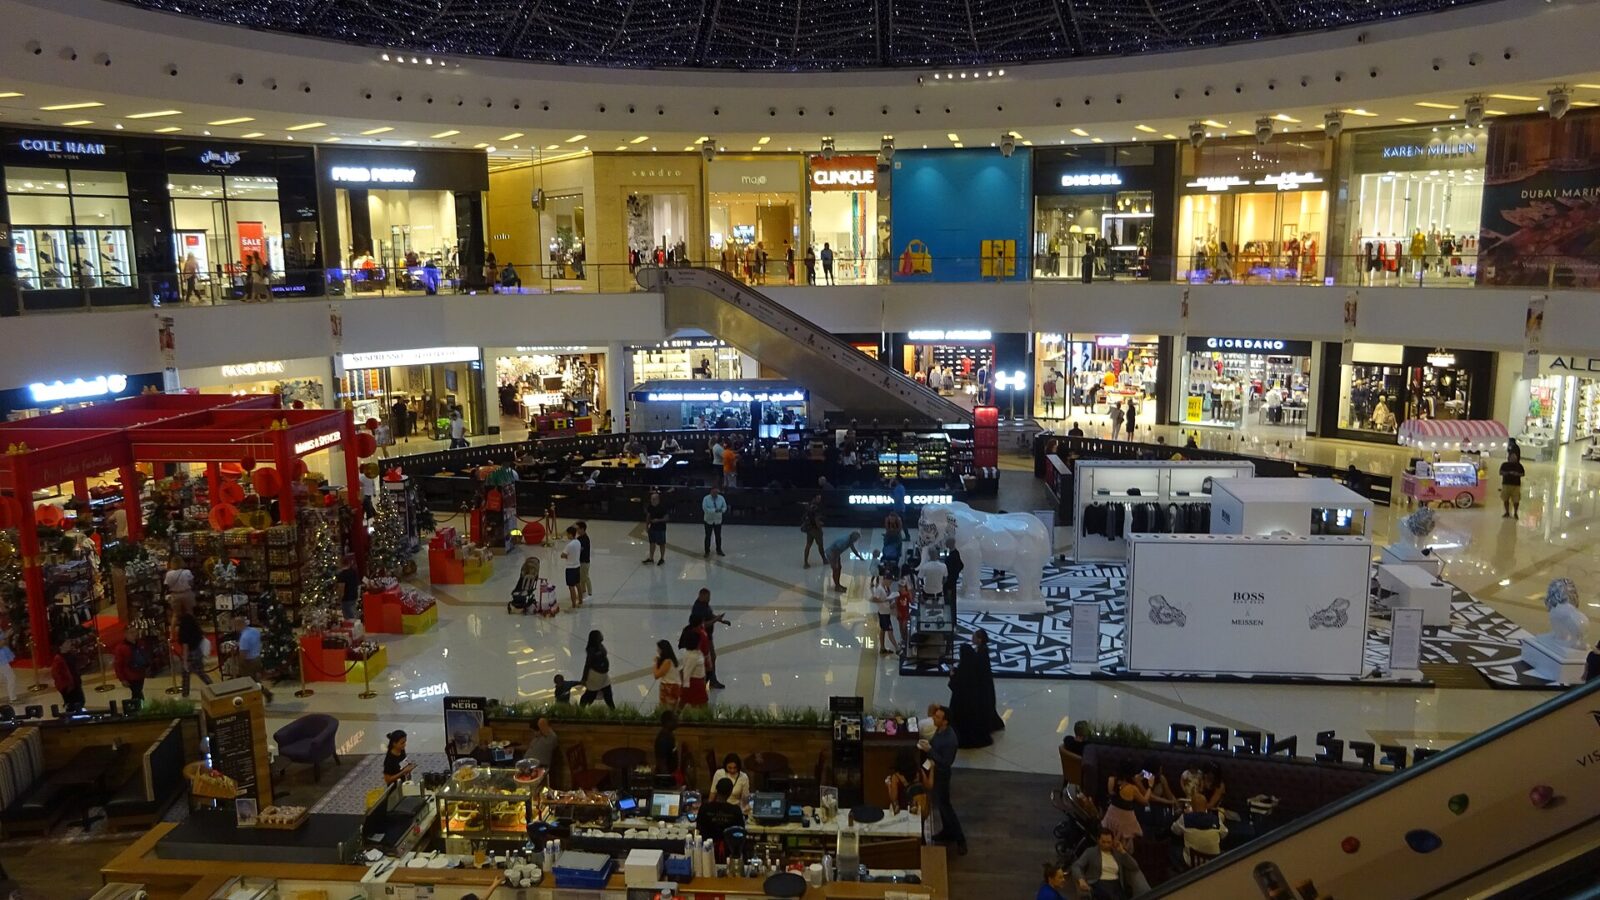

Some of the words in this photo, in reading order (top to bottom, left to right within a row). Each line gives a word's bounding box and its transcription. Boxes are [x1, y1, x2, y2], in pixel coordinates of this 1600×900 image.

[21, 139, 62, 153] COLE
[66, 142, 106, 156] HAAN
[1383, 145, 1424, 158] KAREN
[1427, 143, 1476, 156] MILLEN
[813, 170, 875, 185] CLINIQUE
[1061, 173, 1122, 186] DIESEL
[1521, 189, 1557, 199] DUBAI
[242, 237, 261, 246] SALE
[1207, 338, 1284, 350] GIORDANO
[222, 361, 284, 377] PANDORA
[319, 431, 341, 446] SPENCER
[912, 495, 953, 504] COFFEE
[1233, 591, 1265, 601] BOSS
[1231, 619, 1264, 627] MEISSEN
